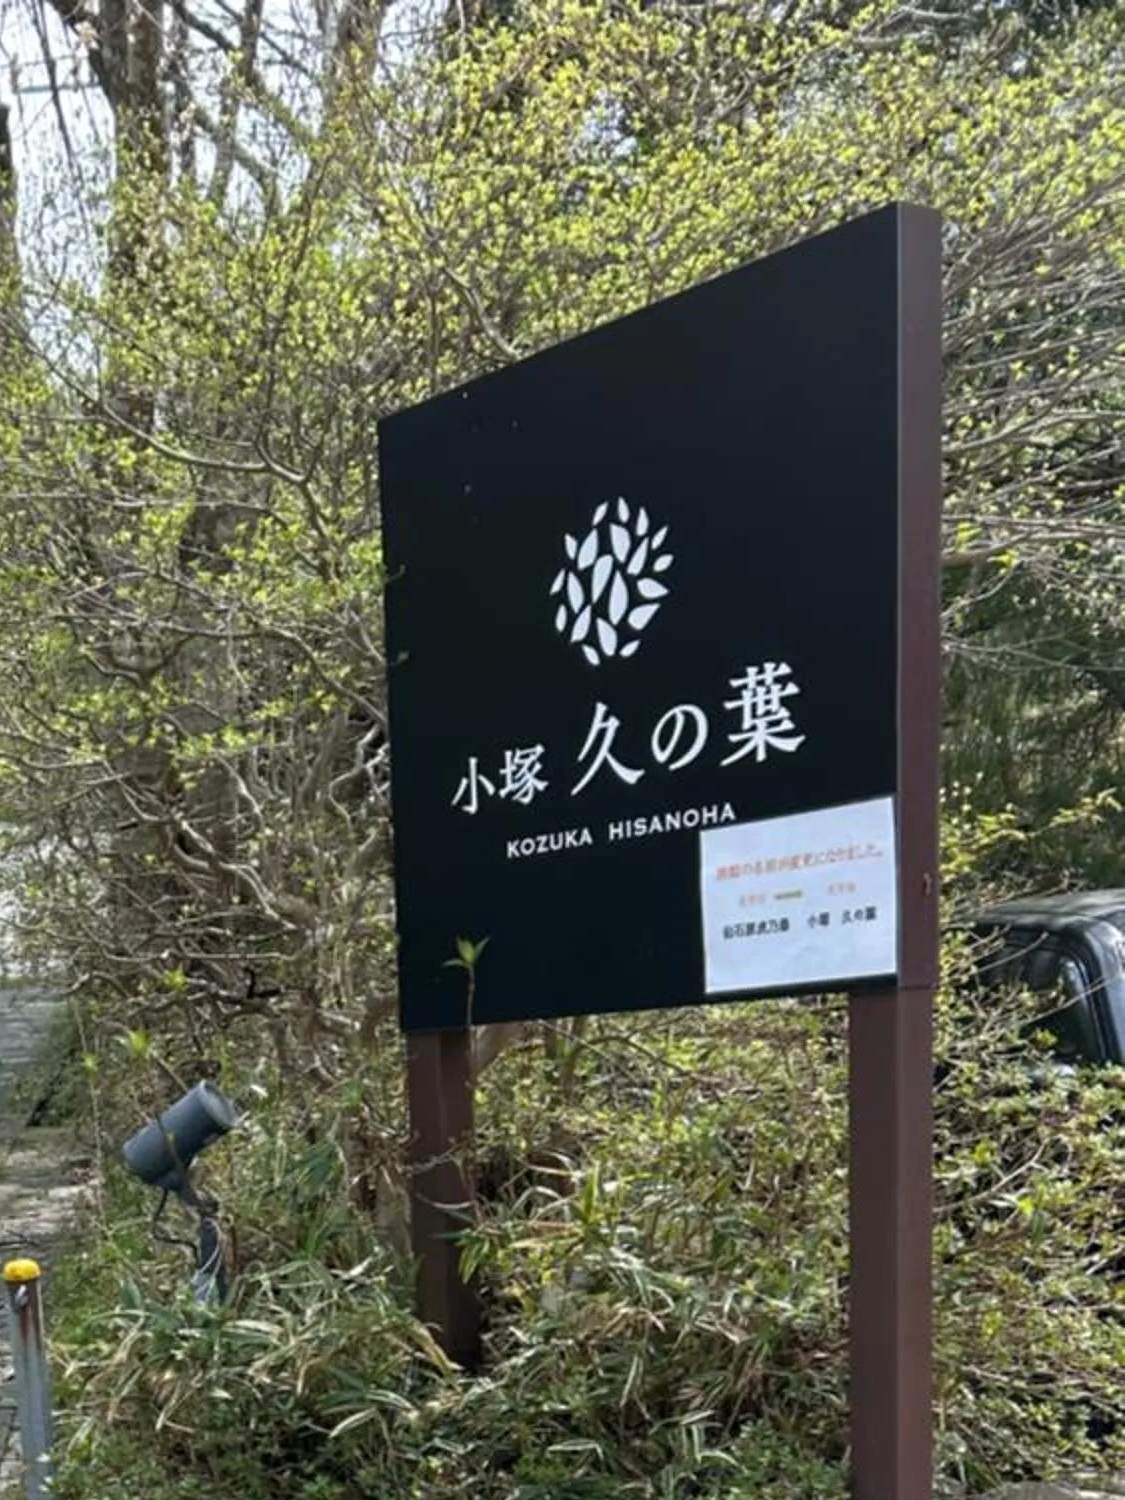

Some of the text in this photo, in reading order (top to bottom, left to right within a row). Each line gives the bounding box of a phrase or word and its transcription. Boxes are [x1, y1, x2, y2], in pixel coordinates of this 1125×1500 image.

[451, 661, 806, 815] 小塚 久の葉
[506, 802, 737, 858] KOZUKA HISANOHA
